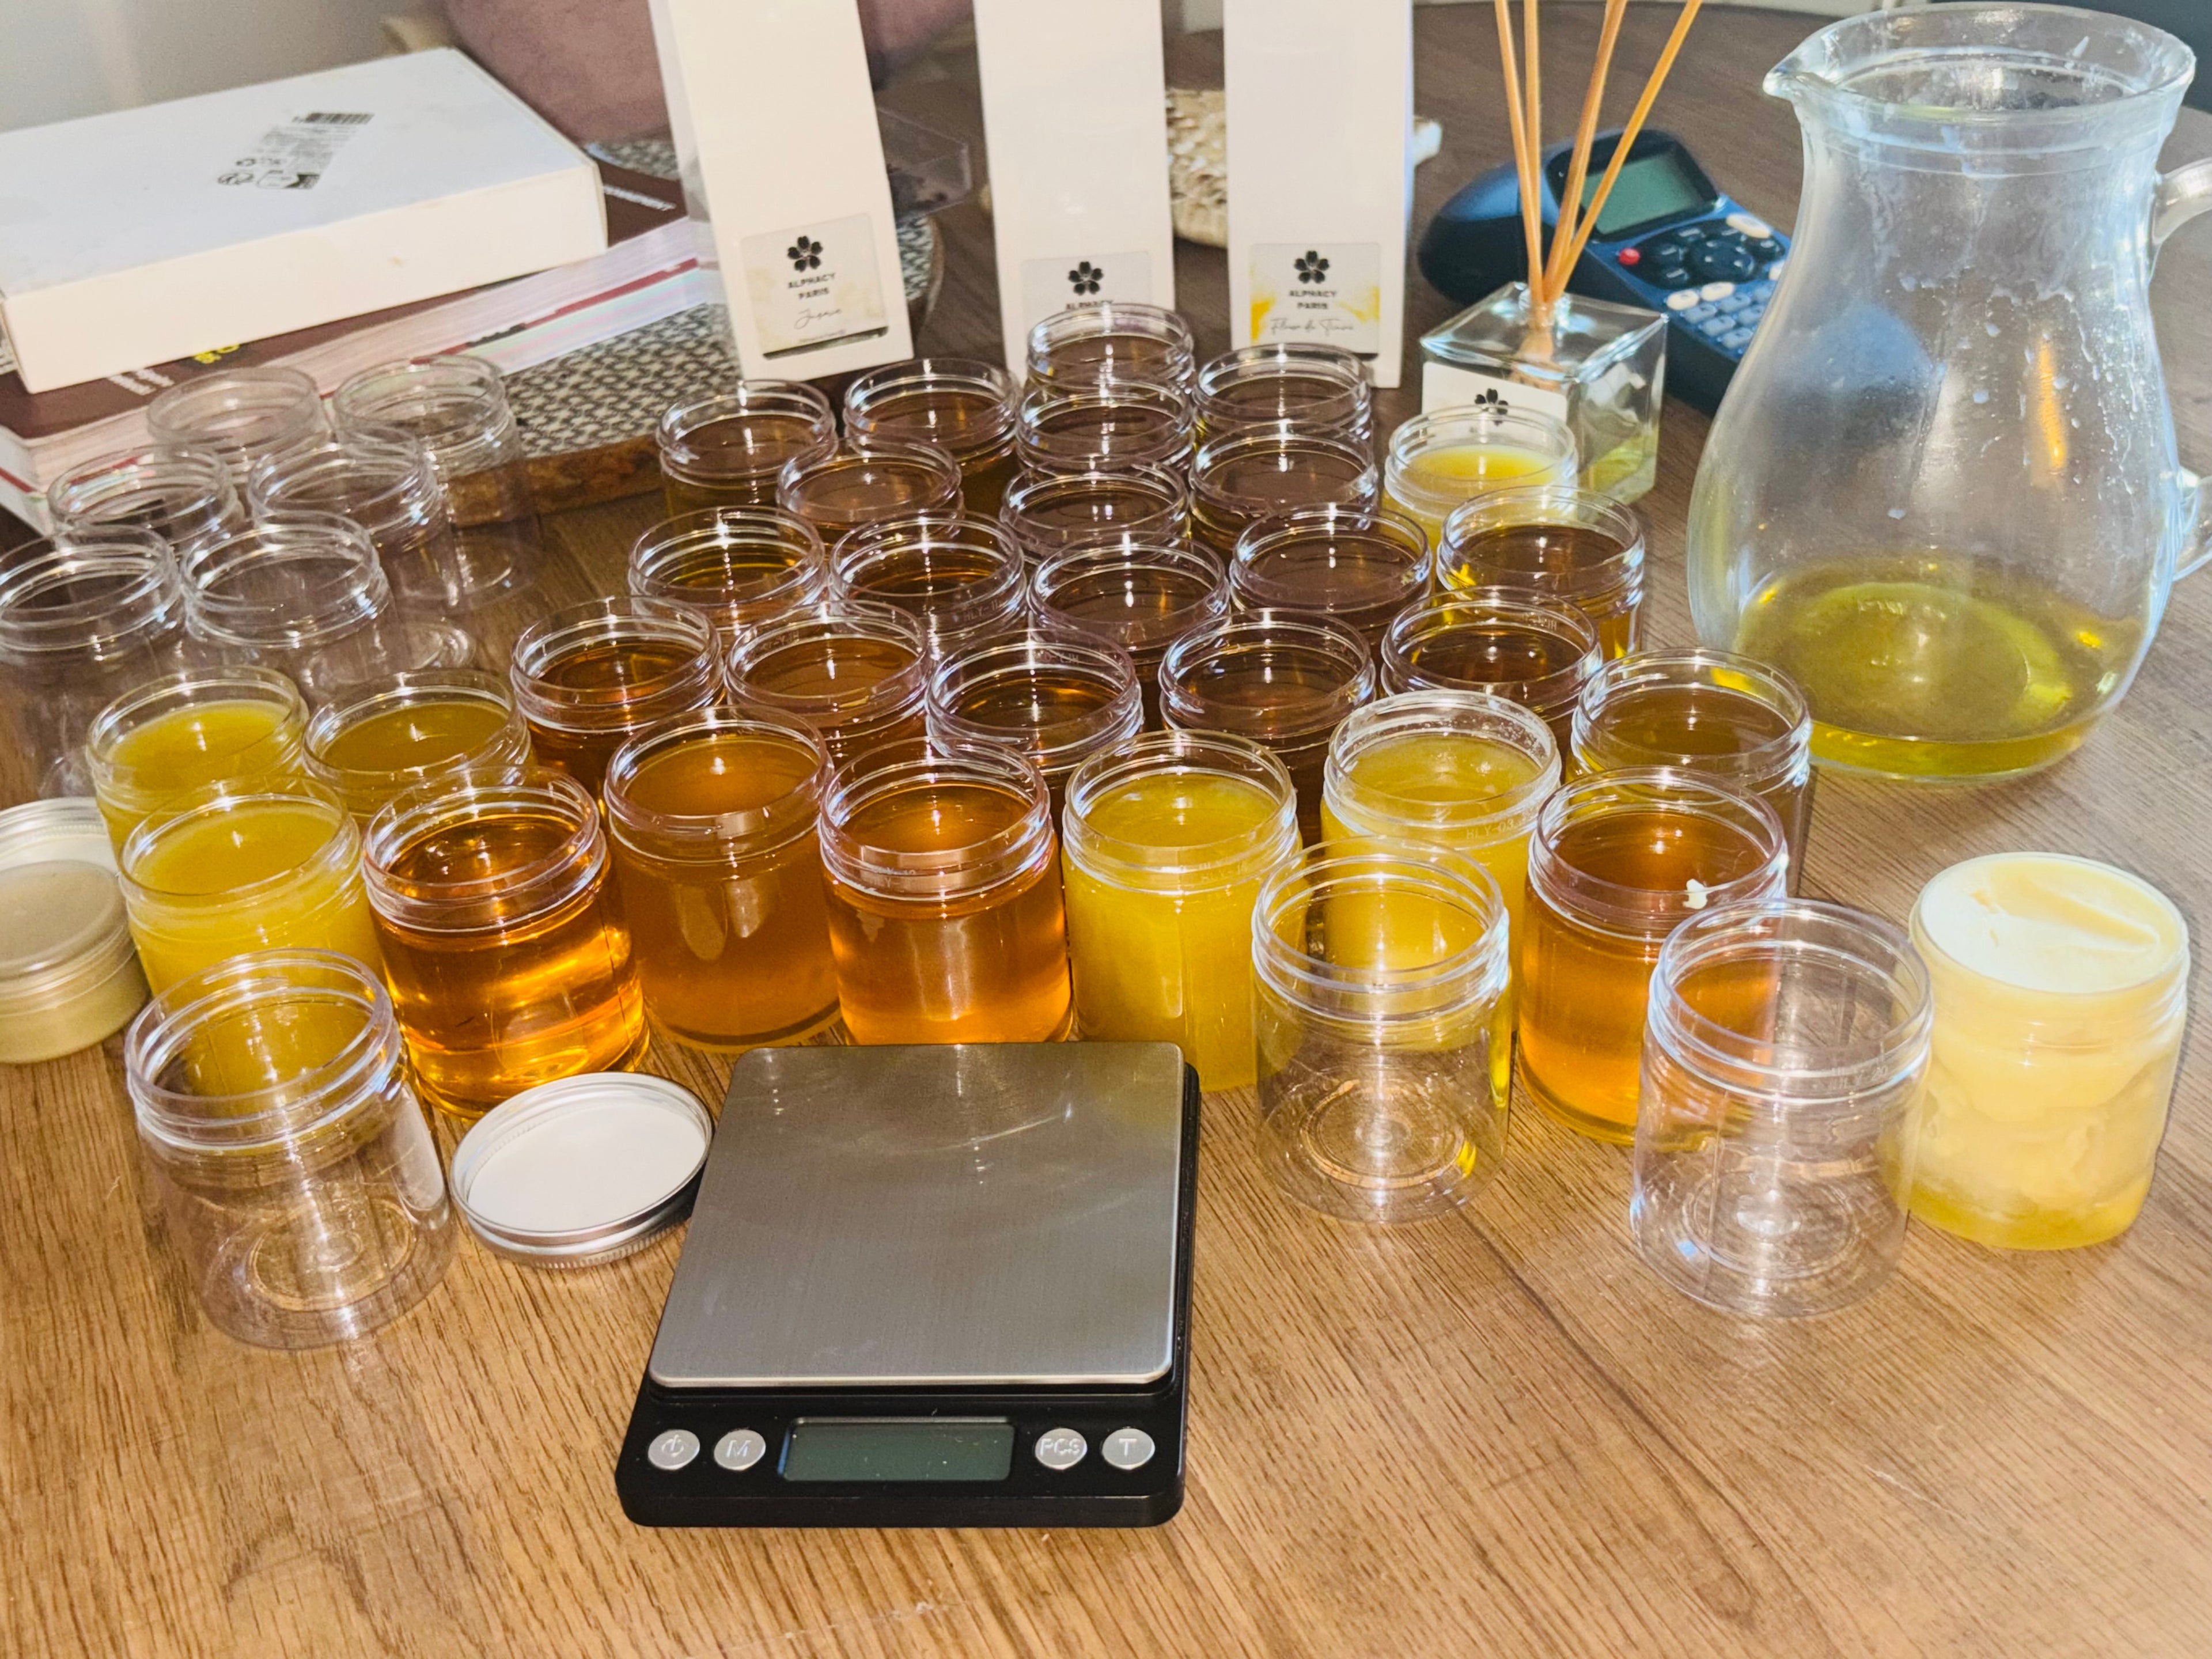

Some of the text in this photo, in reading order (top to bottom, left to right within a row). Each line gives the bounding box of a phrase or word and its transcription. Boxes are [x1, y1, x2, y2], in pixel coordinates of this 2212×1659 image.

[787, 272, 835, 288] ALPHACY
[798, 287, 830, 300] PARIS
[726, 1440, 751, 1457] M
[1040, 1438, 1081, 1456] PCS
[1119, 1438, 1138, 1457] T
